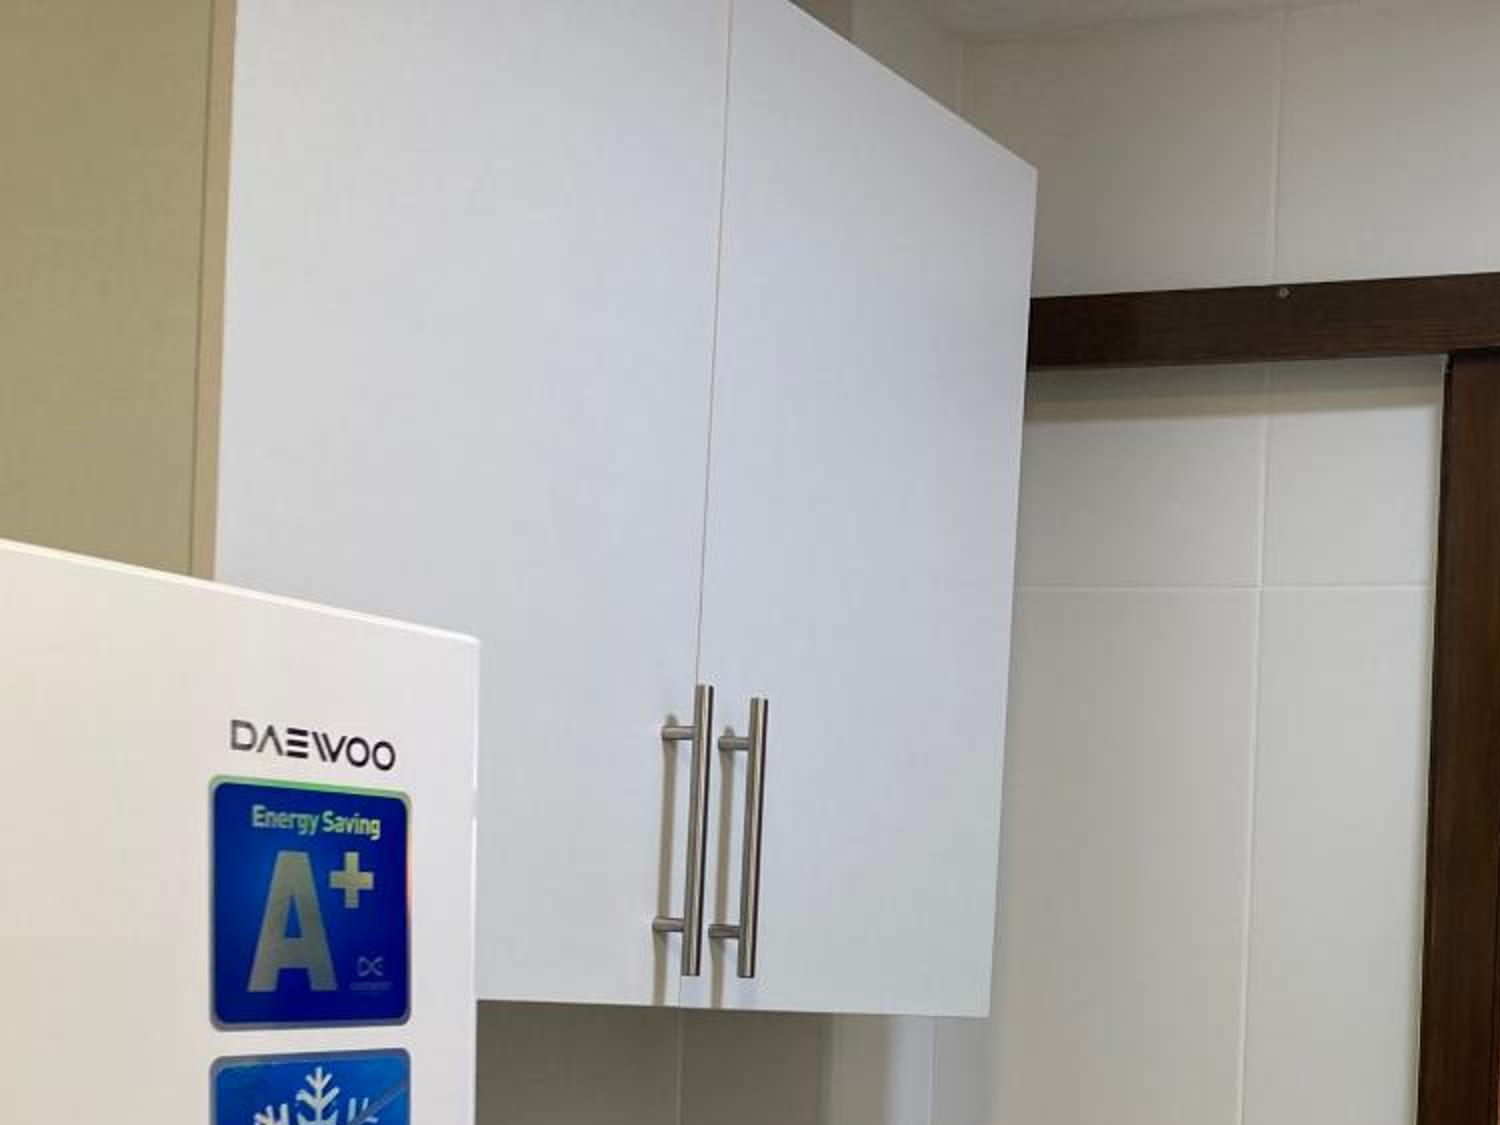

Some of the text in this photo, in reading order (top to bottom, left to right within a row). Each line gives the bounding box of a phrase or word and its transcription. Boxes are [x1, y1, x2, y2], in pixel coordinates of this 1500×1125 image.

[230, 719, 395, 771] DAEWOO
[251, 804, 380, 840] Energy Saving
